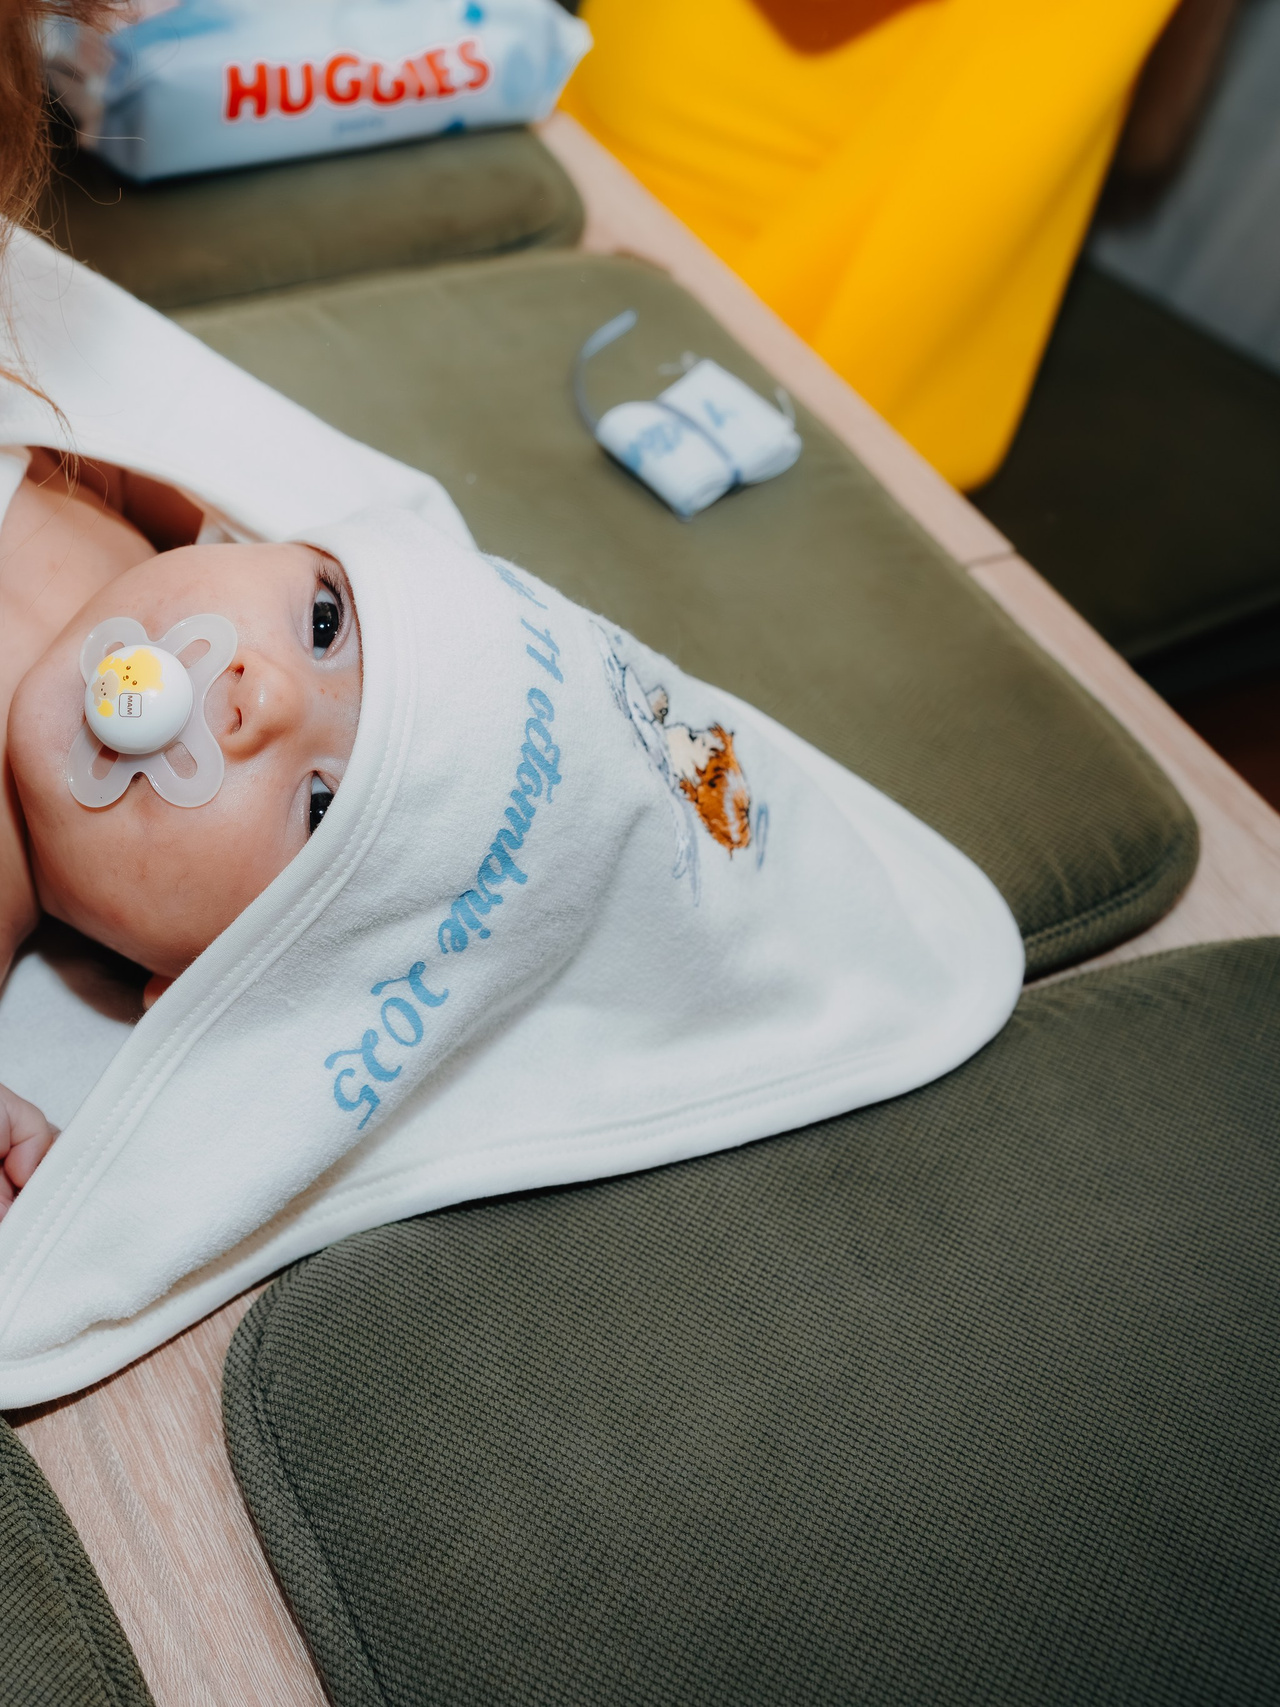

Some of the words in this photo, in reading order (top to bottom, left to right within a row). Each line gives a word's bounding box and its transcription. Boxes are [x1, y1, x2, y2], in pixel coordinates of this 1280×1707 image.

[226, 40, 491, 121] HUGGIES
[437, 687, 563, 955] octombrie
[323, 960, 450, 1131] 2025
